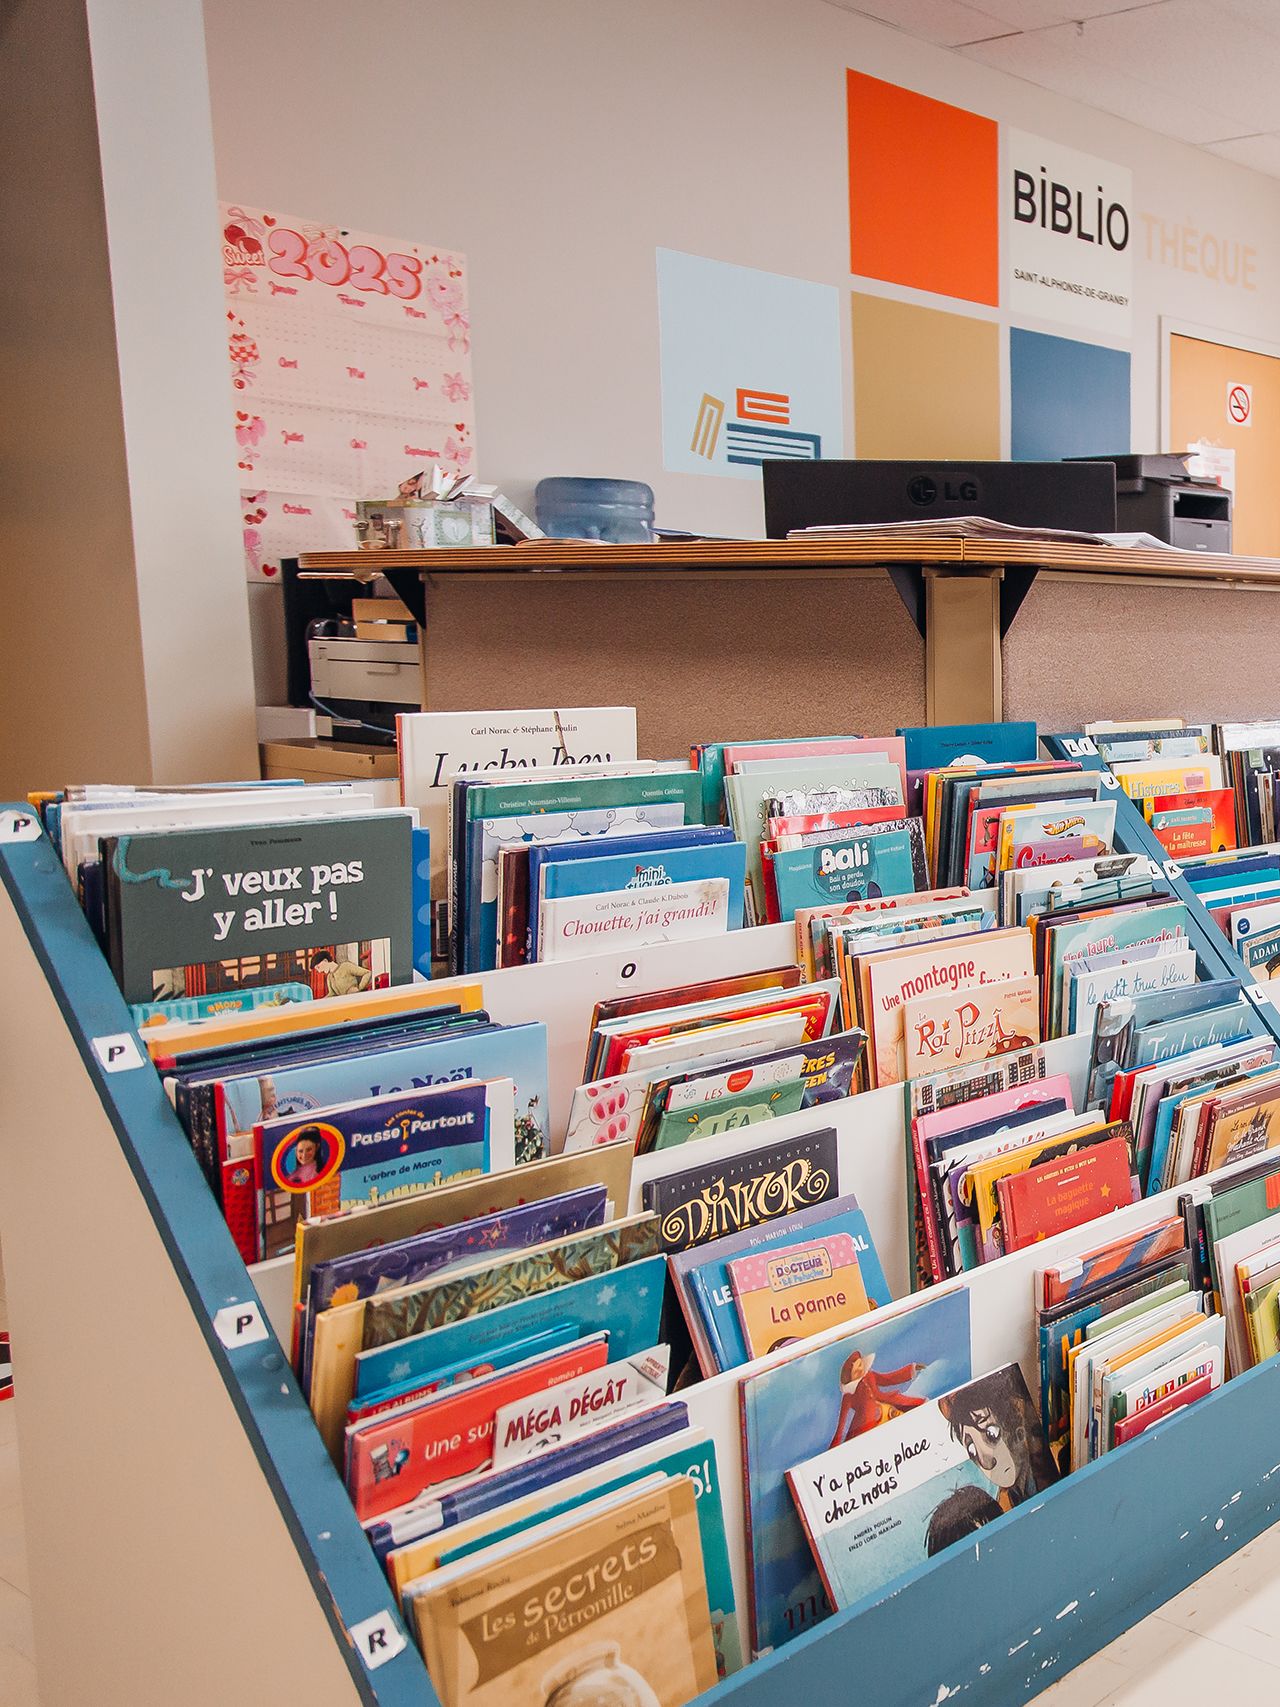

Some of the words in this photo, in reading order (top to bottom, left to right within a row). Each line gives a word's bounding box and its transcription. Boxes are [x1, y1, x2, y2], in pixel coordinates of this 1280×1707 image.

[268, 228, 423, 300] 2025
[1014, 268, 1128, 306] SAINT-ALPHONSE-DE-GRANBY
[944, 481, 977, 501] LG
[470, 726, 487, 736] Carl
[489, 725, 511, 735] Norac
[520, 724, 553, 736] Stéphane
[555, 723, 578, 733] Poulin
[499, 800, 526, 809] Christine
[13, 818, 31, 833] P
[1173, 832, 1181, 841] La
[821, 841, 869, 873] Bali
[222, 866, 304, 896] veux
[310, 860, 364, 895] pas
[637, 866, 663, 882] mini
[829, 884, 841, 893] son
[842, 879, 865, 890] doudou
[847, 871, 864, 881] perdu
[213, 911, 256, 941] y
[244, 898, 322, 931] aller
[329, 891, 339, 921] !
[595, 903, 610, 911] Carl
[611, 901, 630, 910] Norac
[563, 914, 635, 937] Chouette,
[636, 909, 660, 931] j'ai
[1087, 934, 1115, 957] taupe
[1252, 942, 1279, 961] ADAM
[881, 994, 900, 1012] Une
[901, 961, 975, 1000] montagne
[1086, 983, 1097, 1005] le
[1133, 971, 1157, 995] truc
[1161, 963, 1191, 987] bleu
[915, 1018, 950, 1058] Roi
[108, 1046, 125, 1062] P
[704, 1087, 723, 1101] LES
[351, 1127, 401, 1148] Passe
[411, 1111, 475, 1134] Partout
[363, 1165, 397, 1183] L'arbre
[400, 1163, 411, 1174] de
[413, 1158, 442, 1170] Marco
[671, 1174, 717, 1194] BRIAN
[730, 1143, 821, 1176] PILKINGTON
[1046, 1196, 1056, 1207] La
[1058, 1182, 1095, 1204] baguette
[1055, 1197, 1089, 1217] magique
[775, 1256, 824, 1278] DOCTEUR
[712, 1284, 734, 1307] LE
[771, 1305, 791, 1324] La
[794, 1292, 847, 1321] panne
[236, 1314, 254, 1335] P
[548, 1368, 574, 1386] Roméo
[504, 1406, 562, 1448] MÉGA
[569, 1379, 627, 1422] DÉGÂT
[424, 1433, 460, 1460] une
[846, 1460, 873, 1493] pas
[875, 1459, 892, 1477] de
[894, 1439, 931, 1474] place
[824, 1498, 859, 1524] chez
[861, 1476, 899, 1506] nous
[873, 1516, 893, 1531] POULIN
[482, 1613, 516, 1641] Les
[523, 1535, 658, 1627] secrets
[368, 1628, 388, 1655] R
